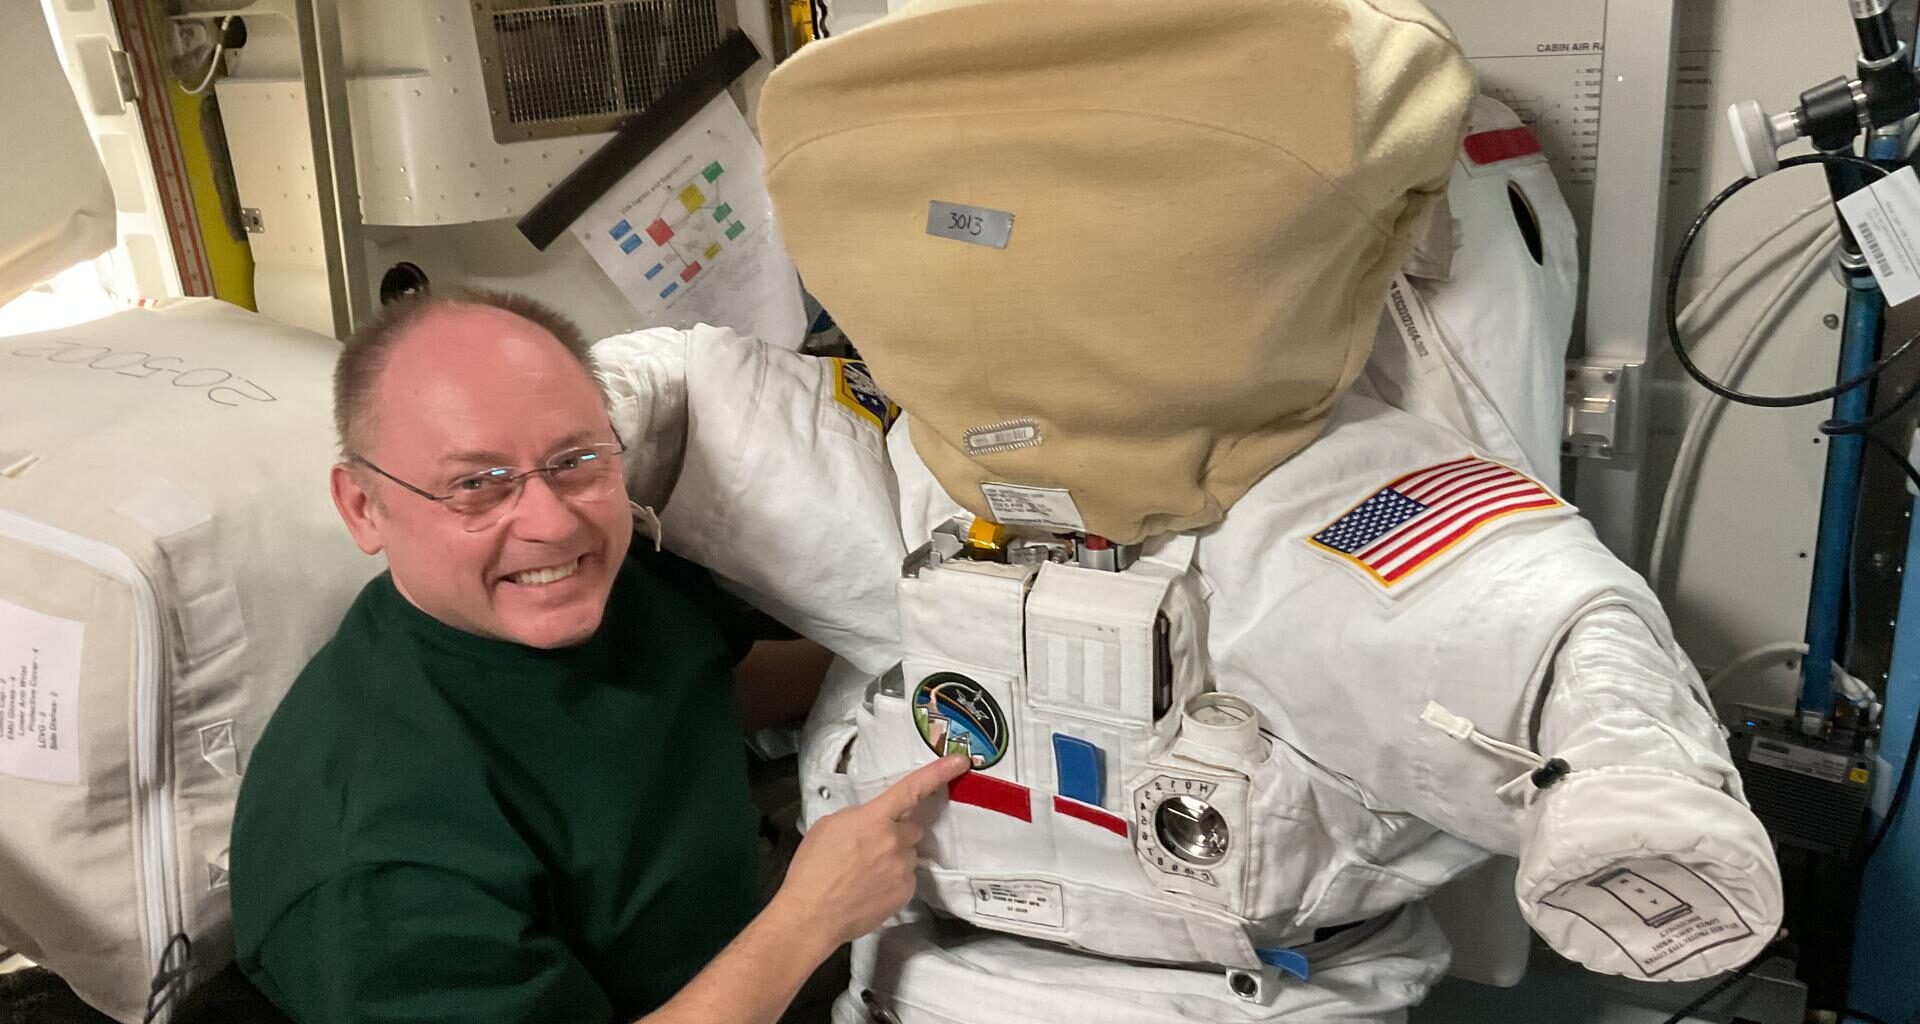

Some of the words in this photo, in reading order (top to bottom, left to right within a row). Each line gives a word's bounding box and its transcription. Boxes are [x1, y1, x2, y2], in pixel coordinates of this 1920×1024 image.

[1536, 43, 1569, 52] CABIN
[1571, 42, 1590, 51] AIR
[947, 212, 984, 236] 3013
[11, 341, 277, 406] 20-5002
[29, 661, 38, 688] Cover
[7, 689, 16, 719] Gloves
[18, 689, 26, 708] Arm
[28, 688, 36, 733] Protective
[7, 720, 15, 740] EMU
[17, 710, 25, 736] Lower
[38, 724, 47, 749] LCVG
[1695, 918, 1721, 929] LOWER
[1652, 938, 1675, 952] WRIST
[1668, 930, 1710, 954] PROTECTIVE
[1643, 950, 1668, 965] COVER
